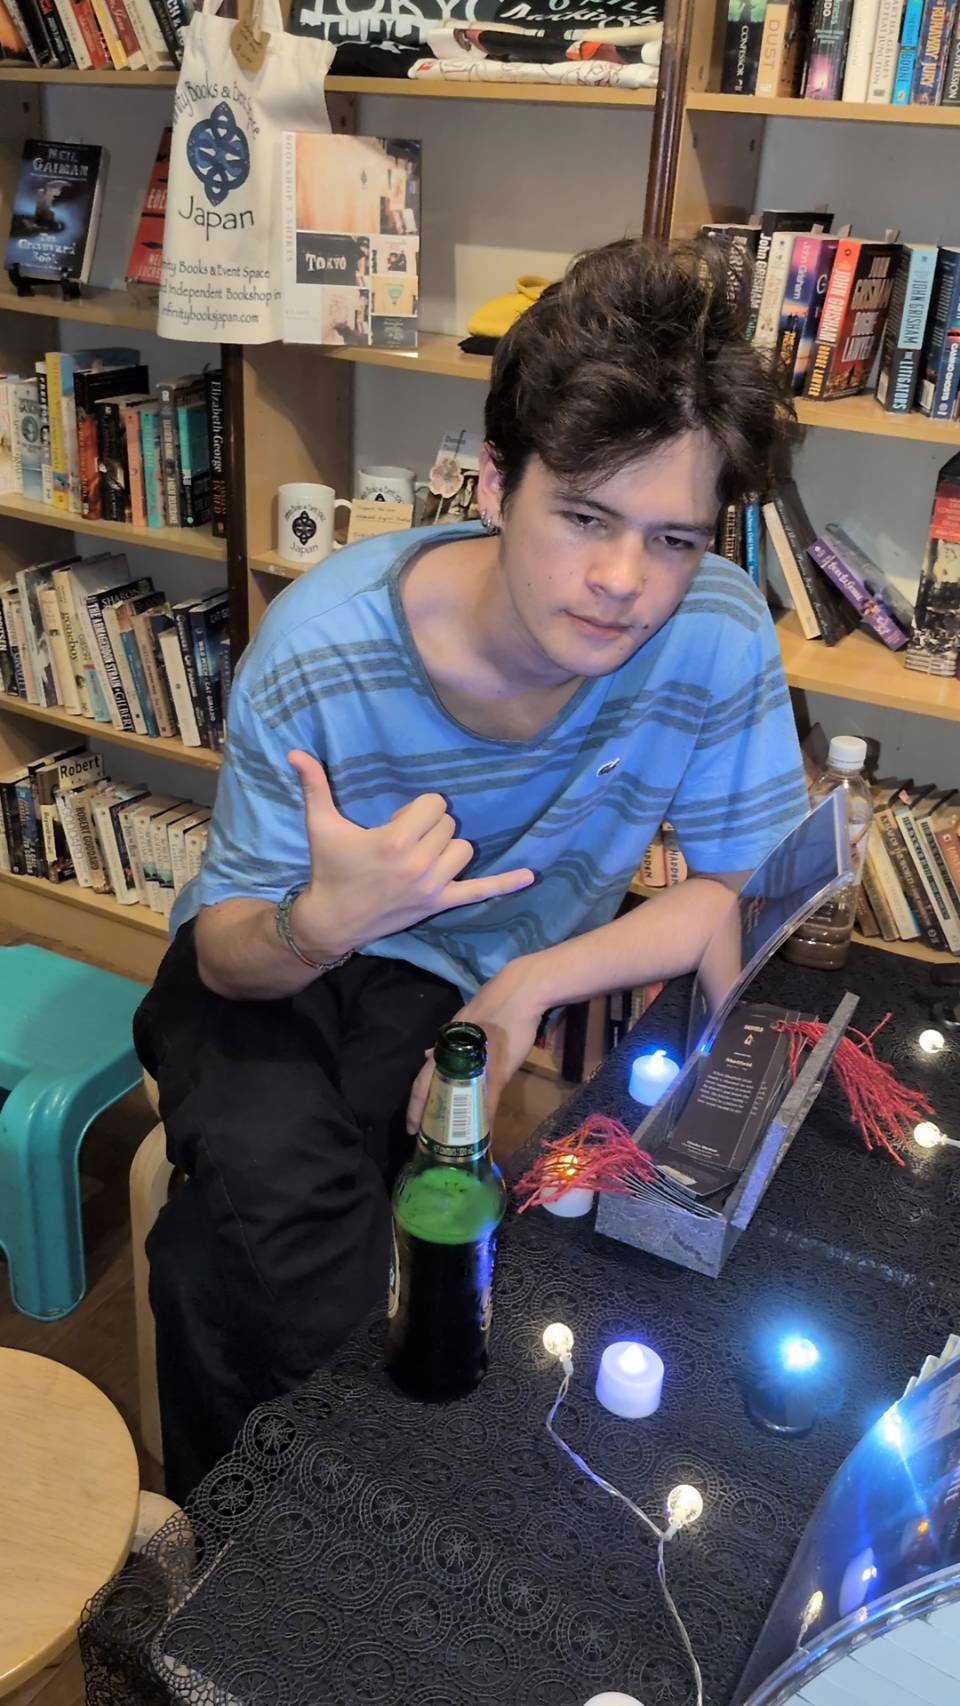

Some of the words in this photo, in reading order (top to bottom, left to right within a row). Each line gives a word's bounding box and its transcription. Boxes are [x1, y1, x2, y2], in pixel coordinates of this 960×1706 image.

[889, 0, 899, 34] ARTHA
[764, 19, 781, 69] DUST
[925, 7, 946, 59] RUNAWAY
[185, 70, 218, 102] Books
[919, 60, 937, 87] JURY
[32, 157, 89, 177] GAIMAN
[48, 148, 79, 163] NEIL
[177, 196, 255, 241] Japan
[756, 233, 771, 260] John
[179, 259, 208, 275] Books
[217, 264, 241, 277] Event
[242, 266, 270, 284] Space
[305, 253, 347, 272] TOKYO
[168, 281, 223, 304] Independent
[226, 285, 272, 307] Bookshop
[273, 288, 282, 300] in
[751, 260, 768, 309] GRISHAM
[832, 269, 851, 297] JOHN
[911, 280, 929, 302] JOHN
[818, 298, 842, 346] GRISHAM
[903, 303, 925, 345] GRISHAM
[807, 368, 825, 397] LAWYER
[892, 361, 914, 410] LITIGATORS
[211, 381, 224, 434] Elizabeth
[212, 434, 224, 473] George
[213, 495, 224, 514] RED
[290, 542, 318, 557] Japan
[87, 603, 101, 619] THE
[61, 612, 78, 663] goneboy
[92, 617, 114, 664] ARMAGEDDON
[105, 663, 121, 688] STRAIN
[204, 681, 212, 694] CAT
[114, 691, 133, 731] GILBERT
[60, 755, 100, 779] Robert
[76, 806, 91, 835] ROBERT
[82, 836, 99, 871] GODDARD
